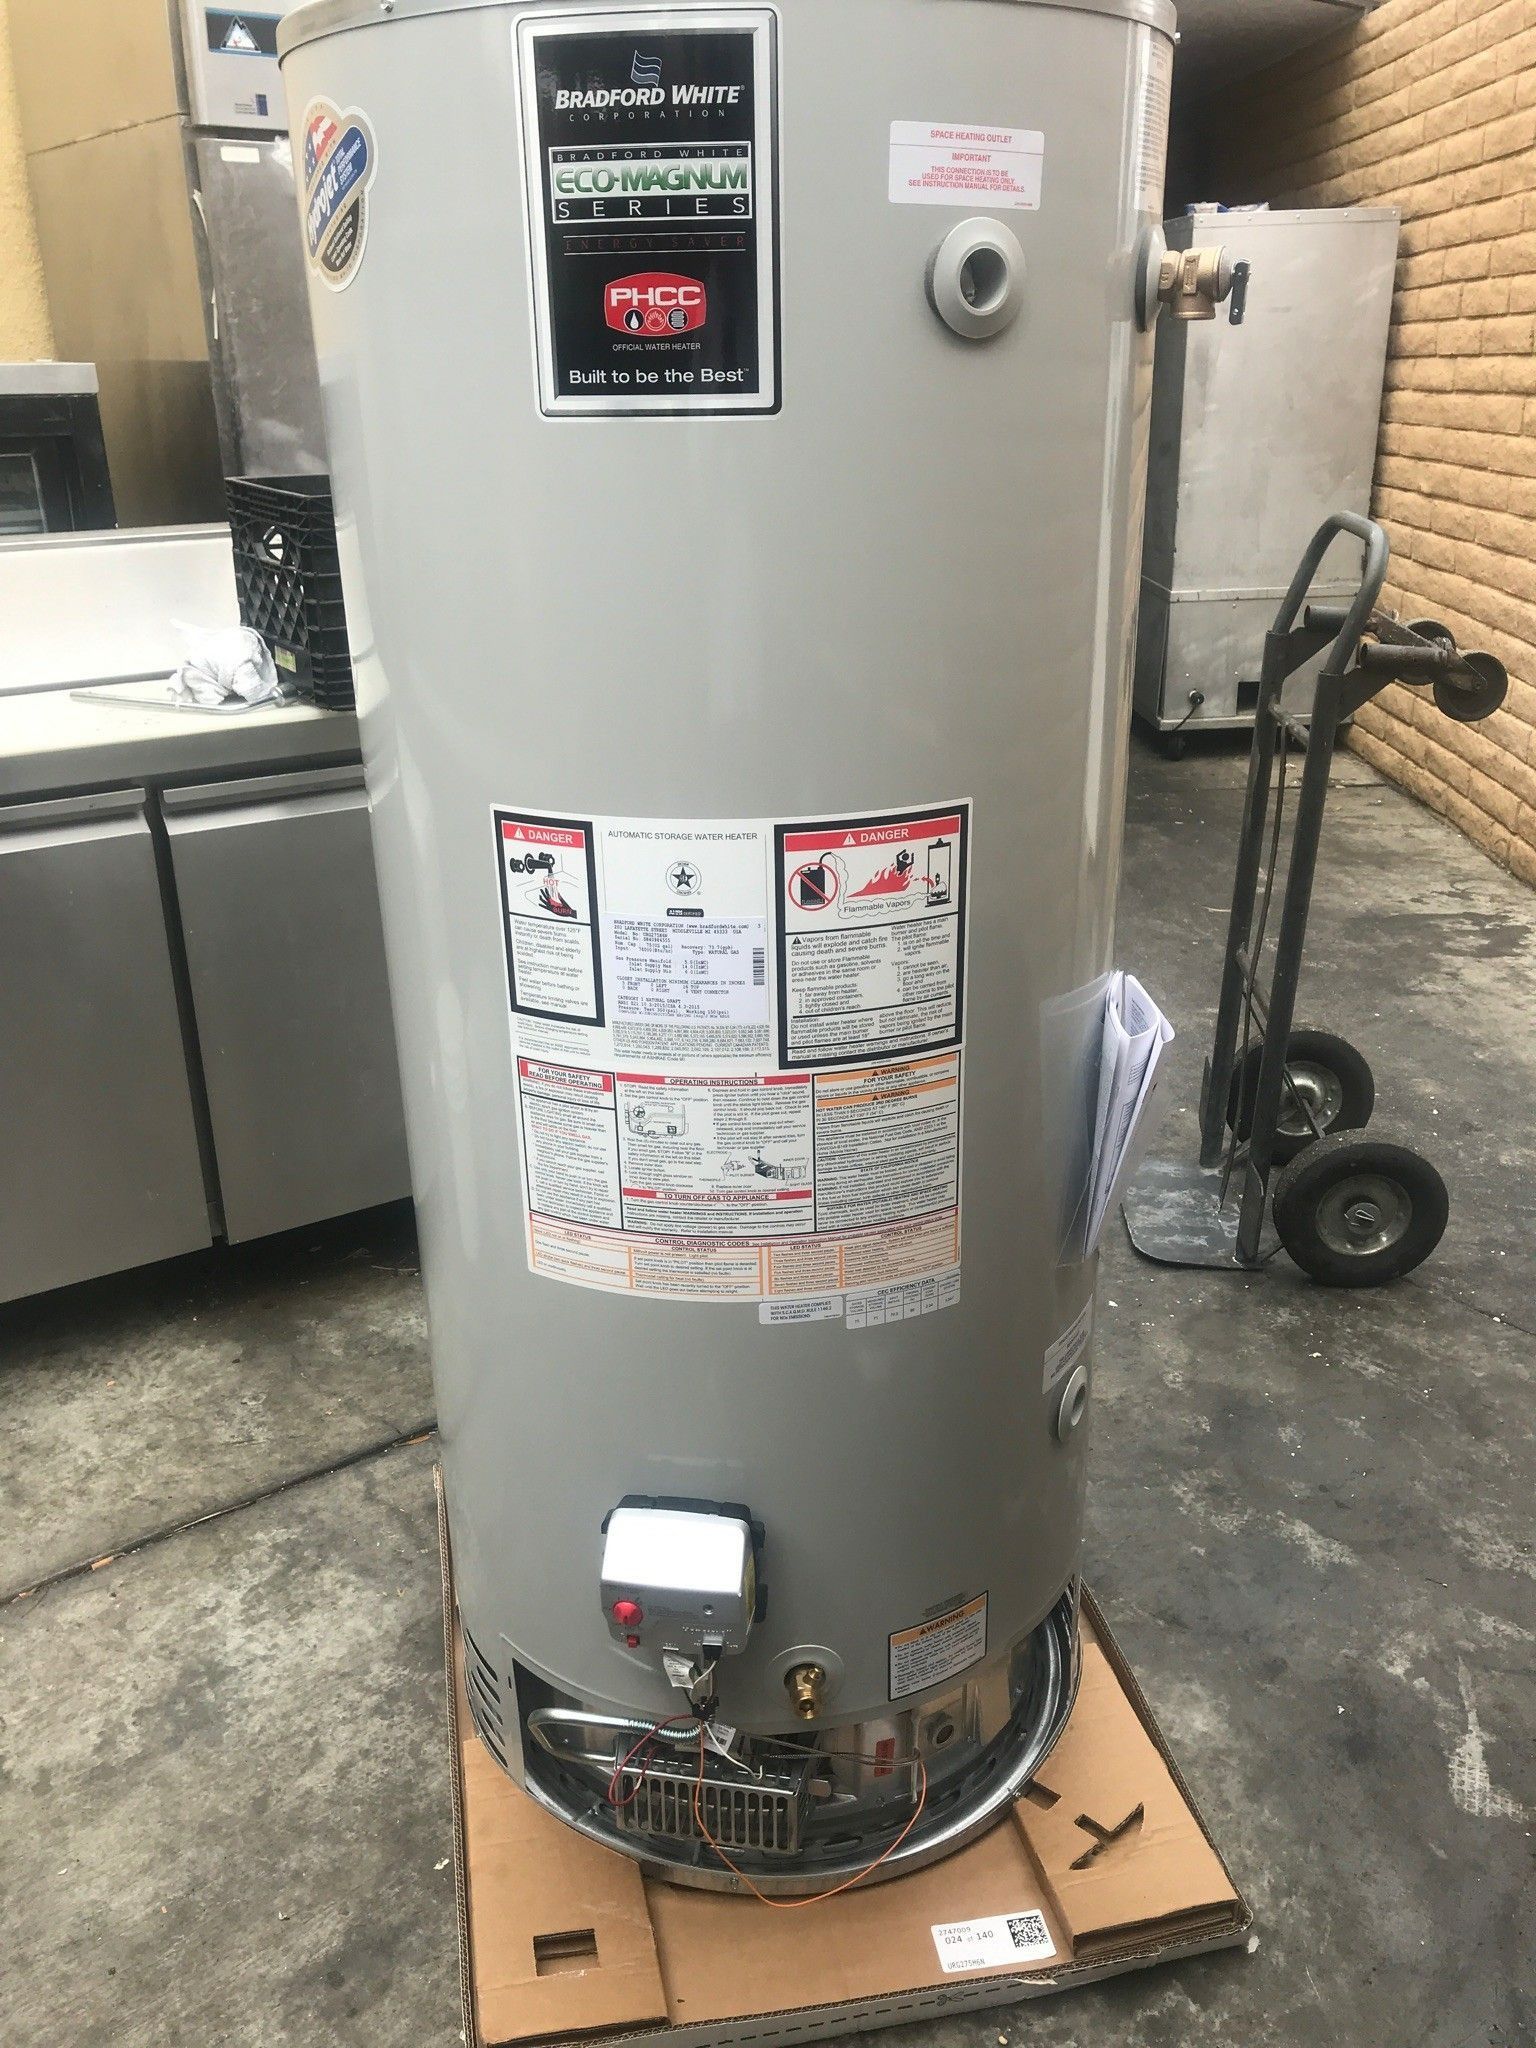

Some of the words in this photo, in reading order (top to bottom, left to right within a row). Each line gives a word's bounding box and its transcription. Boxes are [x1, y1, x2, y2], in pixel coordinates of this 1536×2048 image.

[555, 87, 665, 110] BRADFORD
[569, 110, 725, 122] CORPORATION
[931, 130, 954, 139] SPACE
[955, 132, 985, 141] HEATING
[986, 134, 1012, 143] OUTLET
[557, 150, 662, 162] BRADFORD
[680, 148, 743, 158] WHITE
[952, 153, 991, 162] IMPORTANT
[946, 167, 985, 175] CONNECTION
[556, 163, 747, 194] ECO-MAGNUM
[922, 180, 964, 189] INSTRUCTION
[965, 182, 989, 190] MANUAL
[558, 197, 745, 218] SERIES
[565, 234, 654, 252] ENERGY
[672, 235, 745, 248] SAVER
[611, 286, 701, 307] PHCC
[612, 343, 644, 351] OFFICIAL
[646, 342, 670, 350] WATER
[672, 342, 701, 350] HEATER
[569, 369, 607, 385] Built
[611, 370, 630, 383] to
[636, 369, 659, 383] be
[664, 368, 694, 382] the
[528, 830, 573, 844] DANGER
[608, 831, 652, 839] AUTOMATIC
[861, 829, 908, 842] DANGER
[844, 902, 883, 912] Flammable
[887, 900, 910, 910] Vapors
[841, 932, 871, 940] flammable
[824, 941, 847, 949] explode
[881, 1065, 910, 1074] WARNING
[894, 1071, 915, 1079] SAFETY
[545, 1074, 567, 1083] BEFORE
[569, 1079, 602, 1088] OPERATING
[881, 1090, 910, 1099] WARNING
[905, 1226, 922, 1234] STATUS
[890, 1282, 920, 1293] EFFICIENCY
[926, 1610, 964, 1632] WARNING
[938, 1927, 971, 1936] 2747009
[945, 1935, 962, 1944] 024
[977, 1930, 994, 1940] 140
